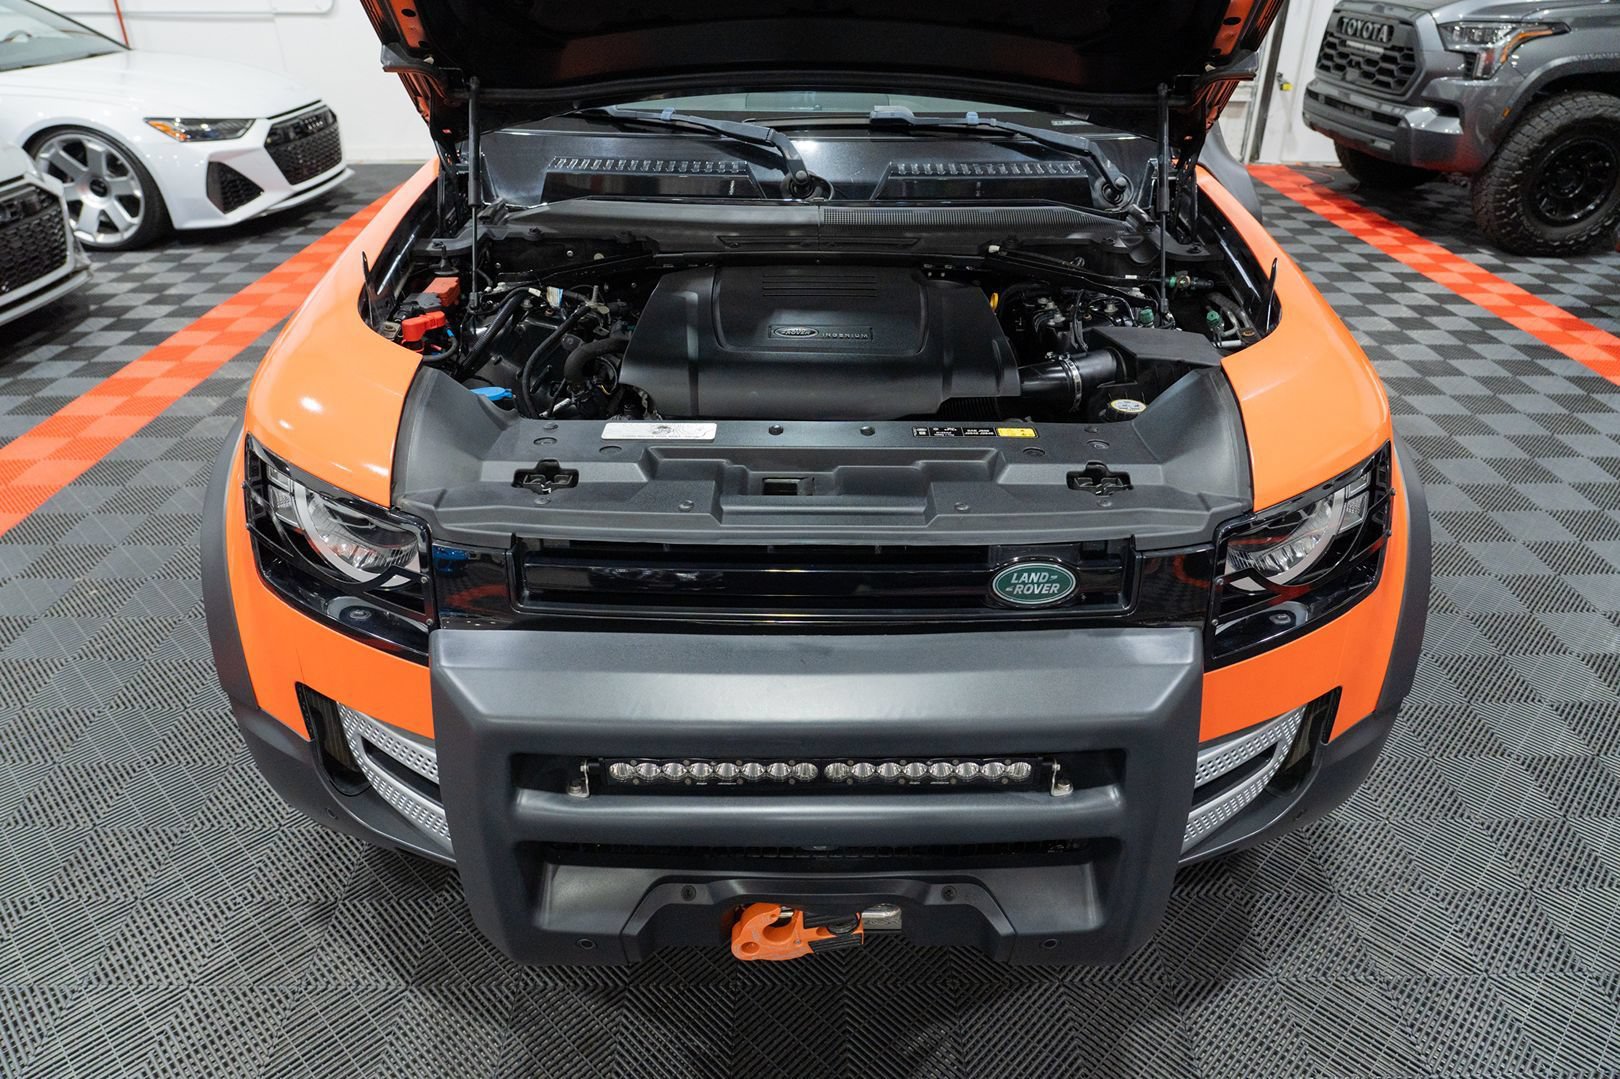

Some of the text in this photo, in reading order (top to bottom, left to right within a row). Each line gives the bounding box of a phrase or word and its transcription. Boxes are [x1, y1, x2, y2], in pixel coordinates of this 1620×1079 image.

[1342, 18, 1387, 42] TOYOTA
[1011, 572, 1049, 584] LAND
[1013, 584, 1060, 594] ROVER
